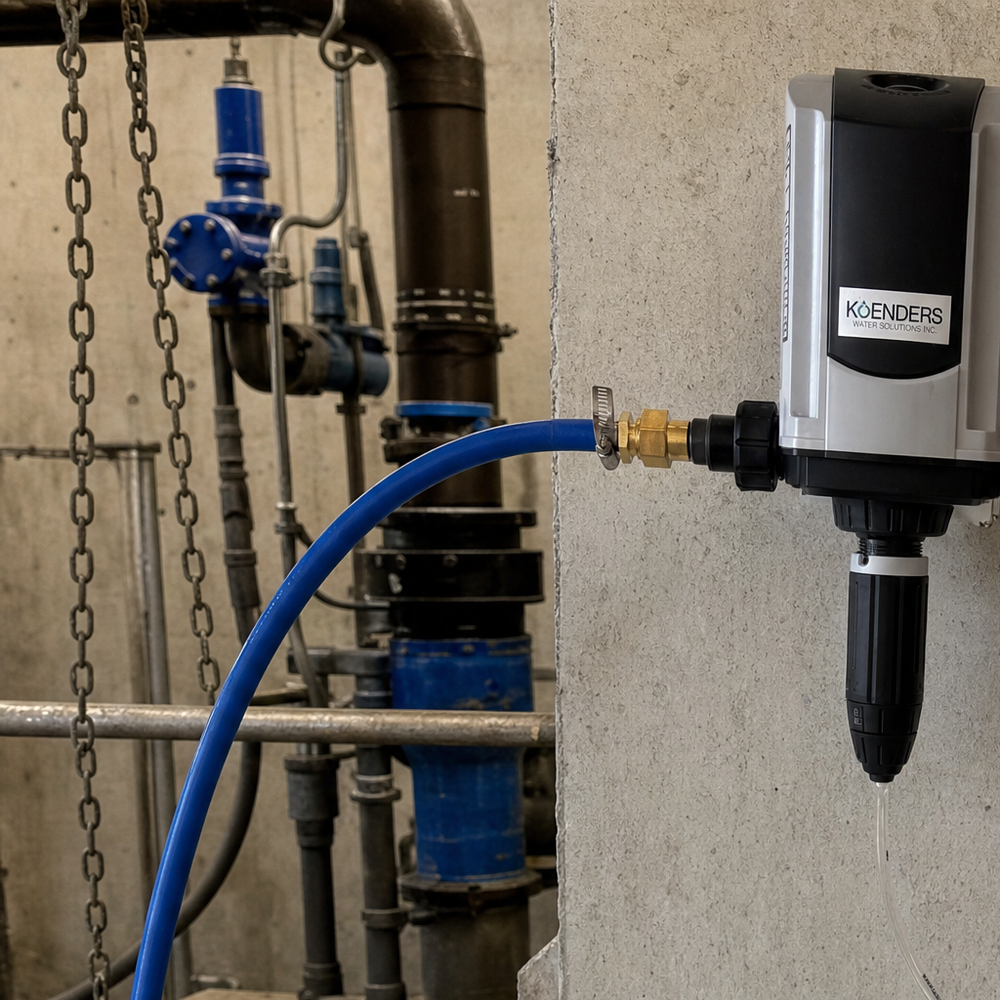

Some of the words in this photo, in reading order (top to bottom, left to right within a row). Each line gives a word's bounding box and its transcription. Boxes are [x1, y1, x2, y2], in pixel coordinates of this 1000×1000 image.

[846, 299, 943, 325] KOENDERS
[852, 319, 878, 329] WATER
[879, 321, 922, 333] SOLUTIONS
